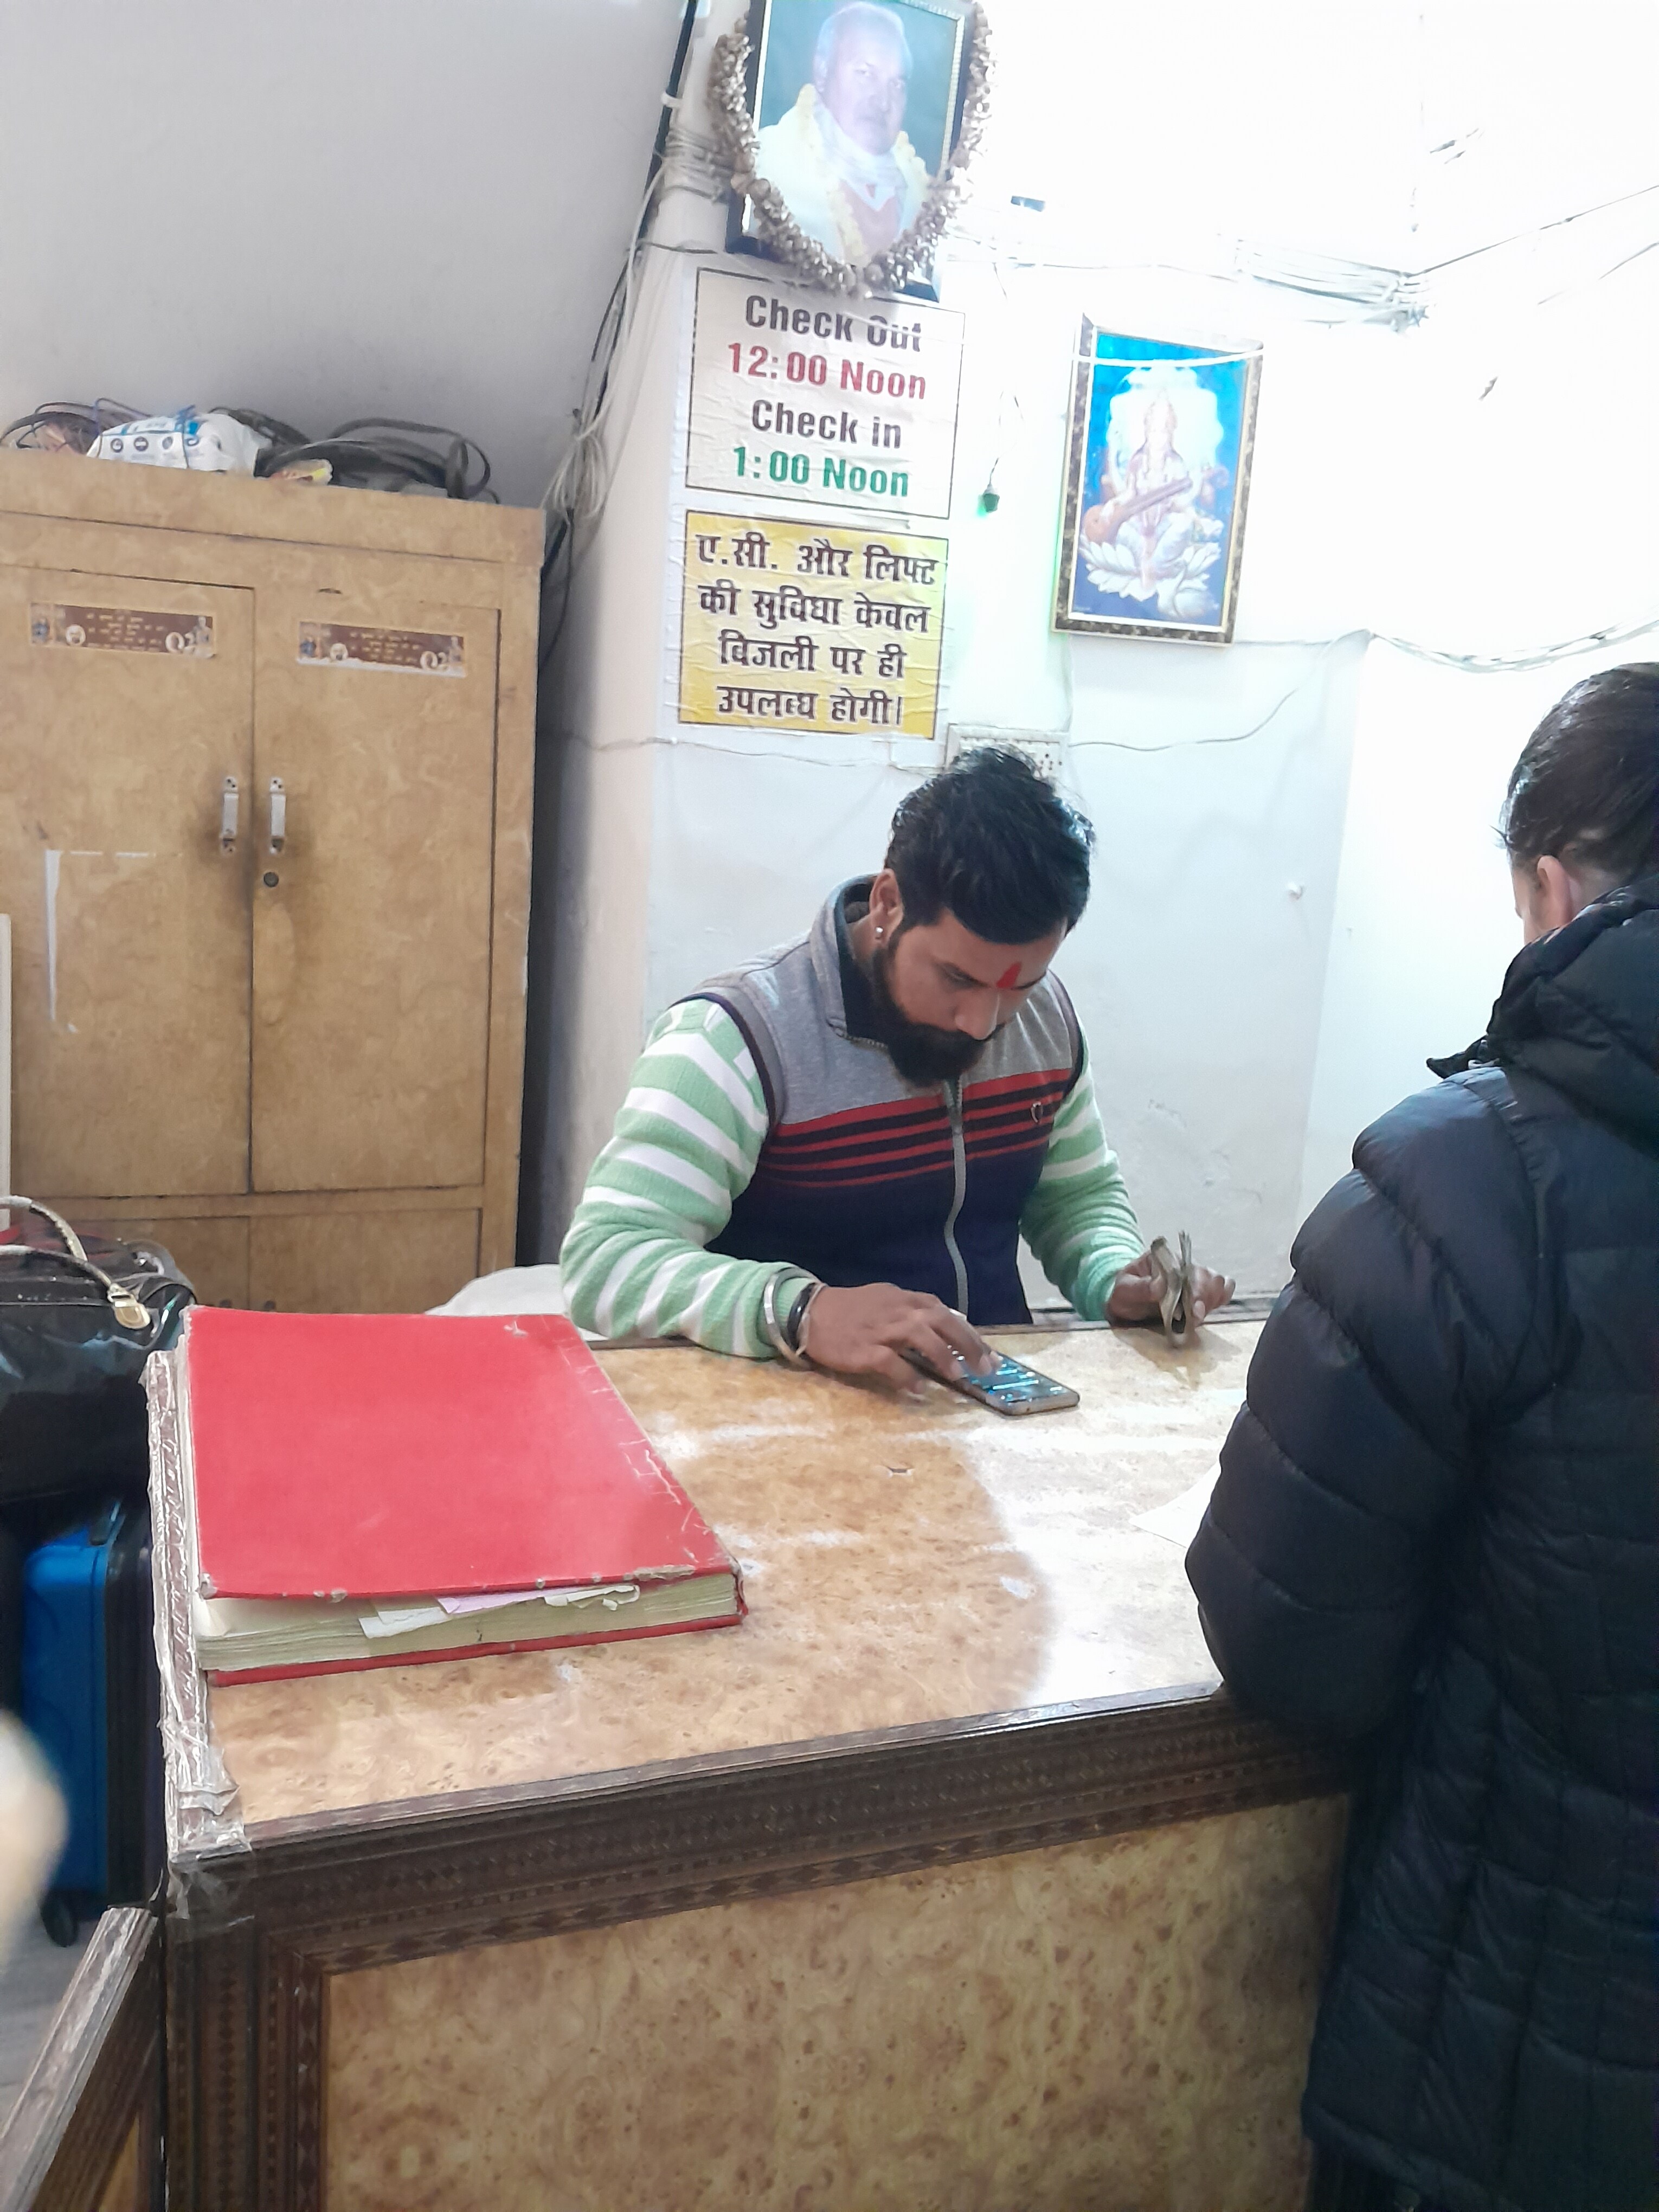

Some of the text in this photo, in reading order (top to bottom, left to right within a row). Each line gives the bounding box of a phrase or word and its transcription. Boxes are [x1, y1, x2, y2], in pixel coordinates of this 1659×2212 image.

[745, 295, 922, 352] Check Out
[728, 342, 927, 400] 12:00 Noon
[751, 399, 902, 449] Check in
[733, 446, 909, 497] 1:00 Noon
[796, 538, 853, 577] और
[863, 544, 939, 585] लिफ्ट
[697, 578, 931, 633] की सुविधा केवल
[829, 647, 866, 675] पर
[877, 644, 907, 678] ही
[716, 685, 819, 719] उपलब्ध
